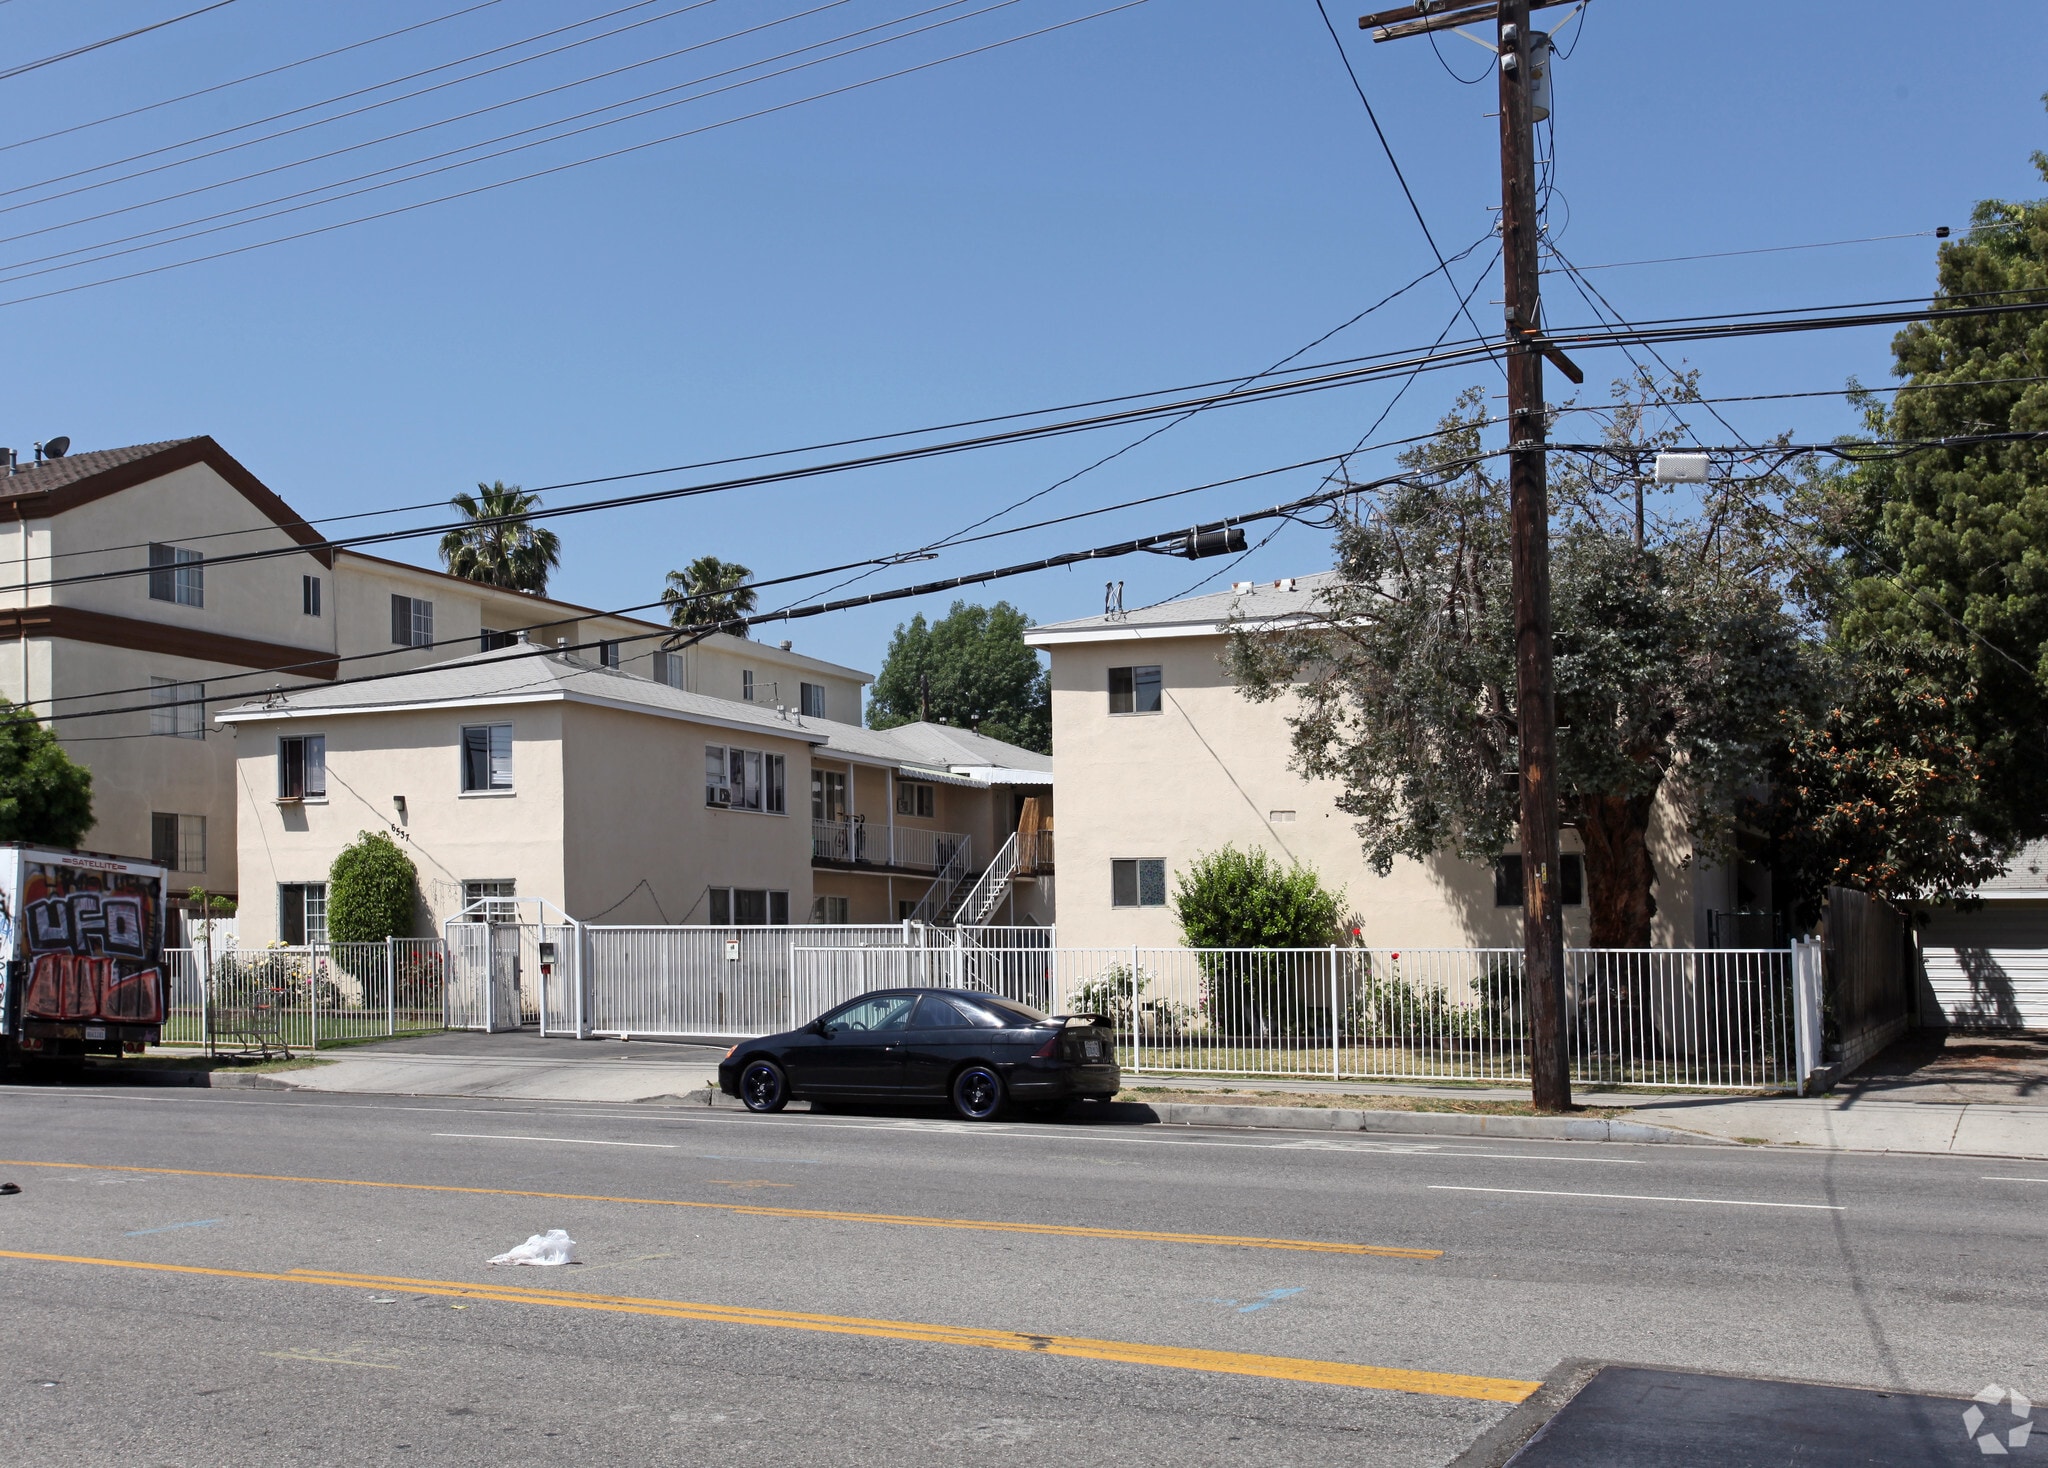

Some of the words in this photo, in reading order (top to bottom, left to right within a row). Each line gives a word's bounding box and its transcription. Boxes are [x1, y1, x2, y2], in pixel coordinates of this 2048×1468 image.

[391, 823, 410, 842] 6537
[71, 858, 118, 870] SATELLITE
[25, 893, 144, 958] UFO
